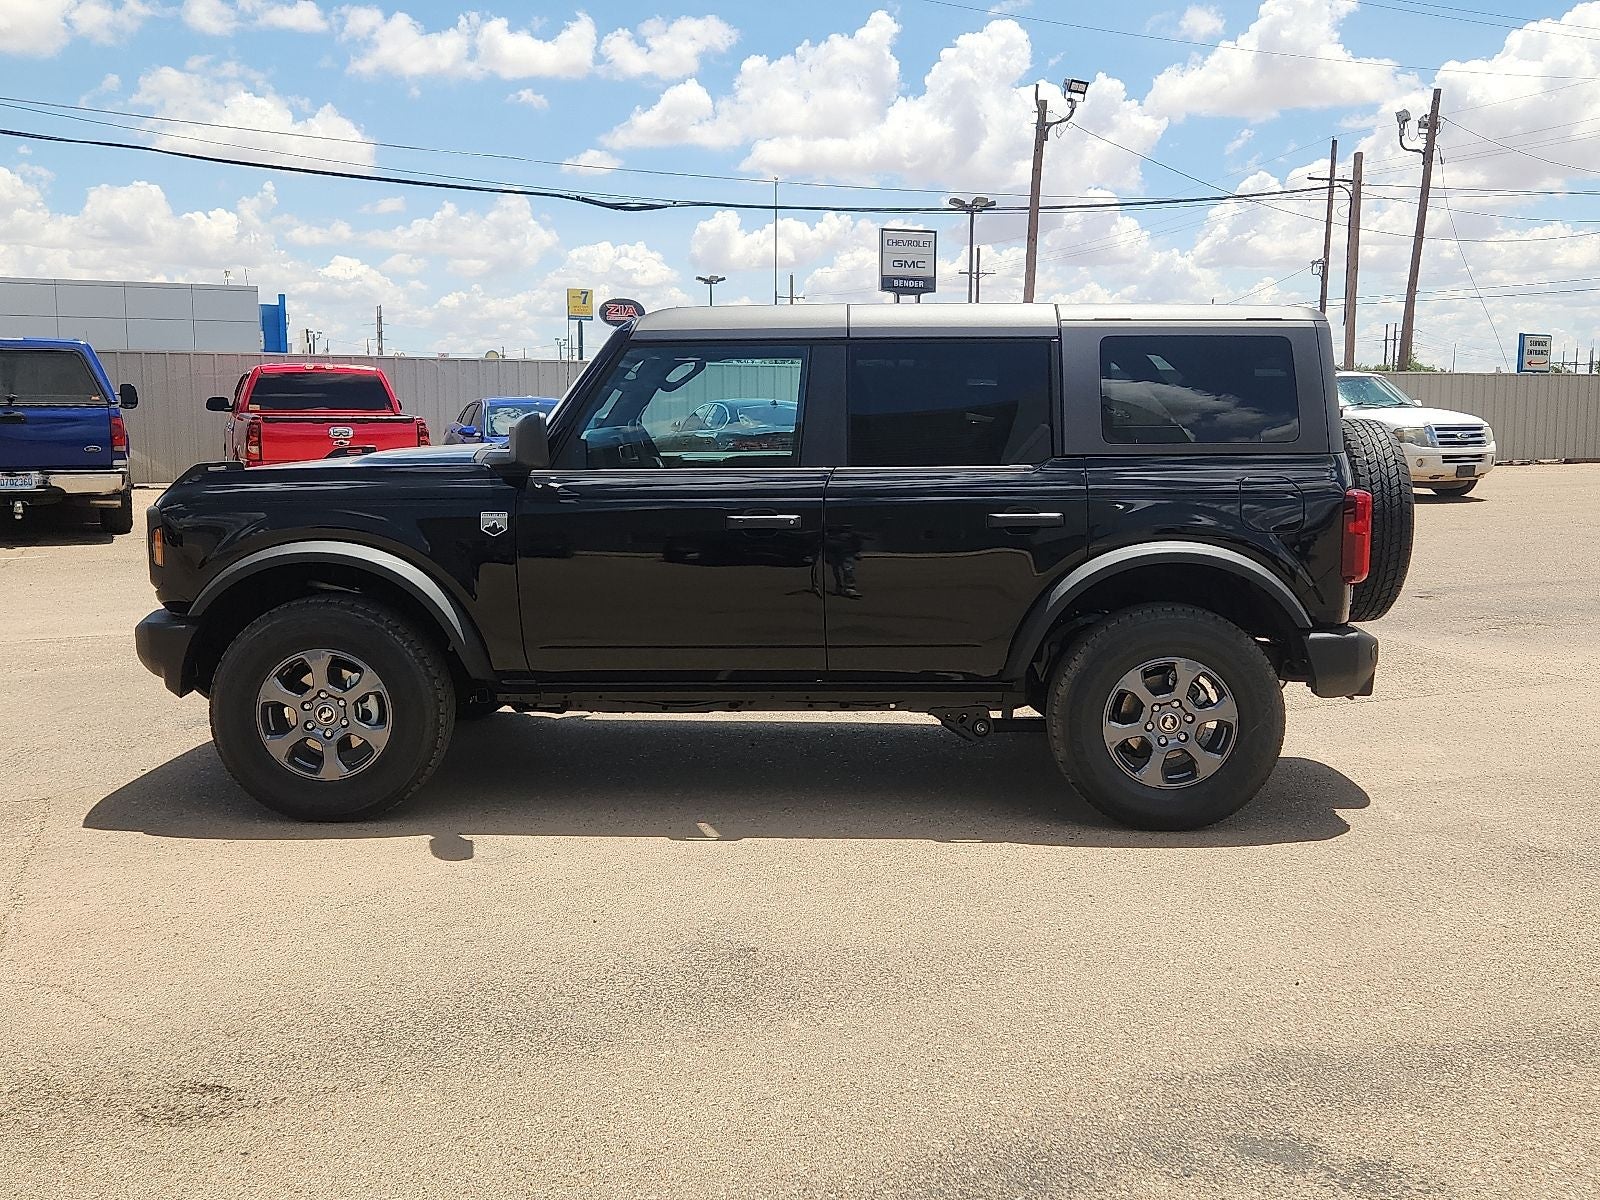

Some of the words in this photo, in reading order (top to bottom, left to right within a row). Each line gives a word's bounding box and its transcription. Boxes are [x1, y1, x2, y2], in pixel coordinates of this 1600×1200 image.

[886, 238, 932, 248] CHEVROLET
[892, 259, 926, 269] GMC
[893, 279, 924, 288] BENDER
[580, 290, 589, 305] 7
[605, 303, 638, 317] ZIA
[1526, 349, 1549, 357] ENTRANCE
